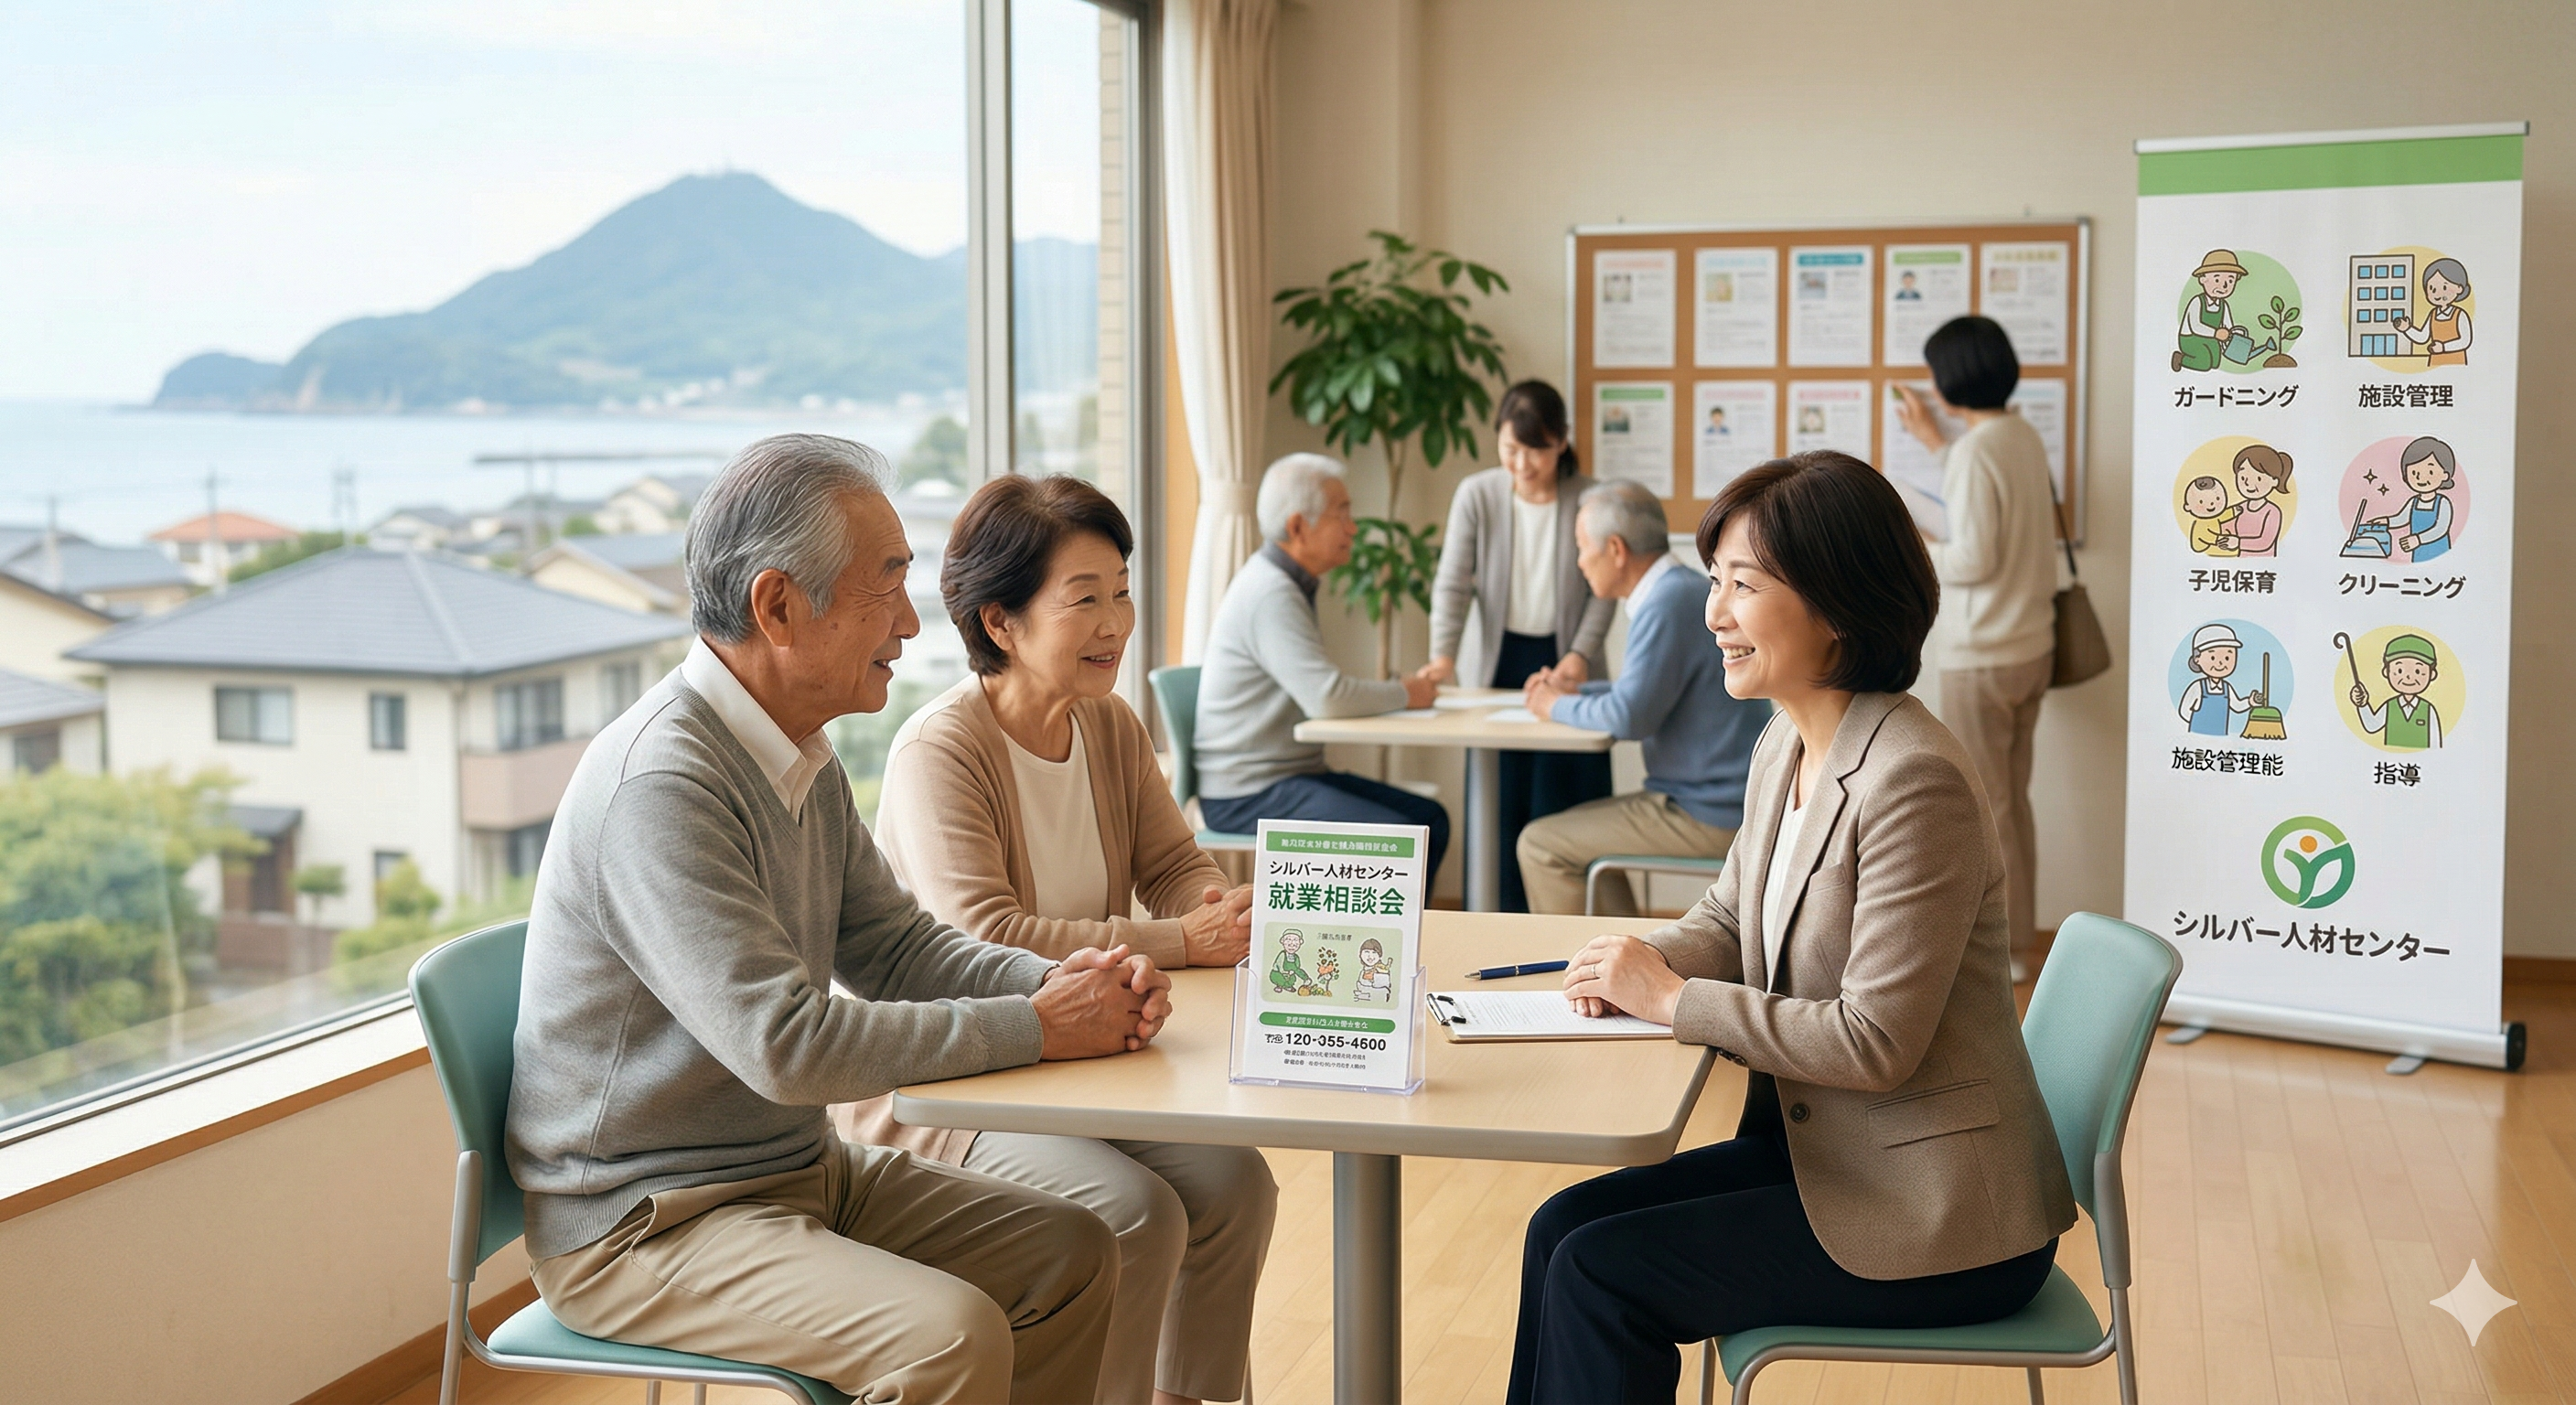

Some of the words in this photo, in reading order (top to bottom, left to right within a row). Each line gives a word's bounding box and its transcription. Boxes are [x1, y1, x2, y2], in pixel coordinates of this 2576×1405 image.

[2174, 383, 2299, 408] ガードニング
[2358, 383, 2453, 408] 施設管理
[2188, 569, 2277, 595] 子児保育
[2338, 573, 2467, 599] クリーニング
[2171, 746, 2284, 777] 施設管理能
[2373, 761, 2421, 787] 指導
[1270, 861, 1409, 881] シルバー人材センター
[1268, 881, 1406, 916] 就業相談会
[2173, 910, 2451, 961] シルバー人材センター
